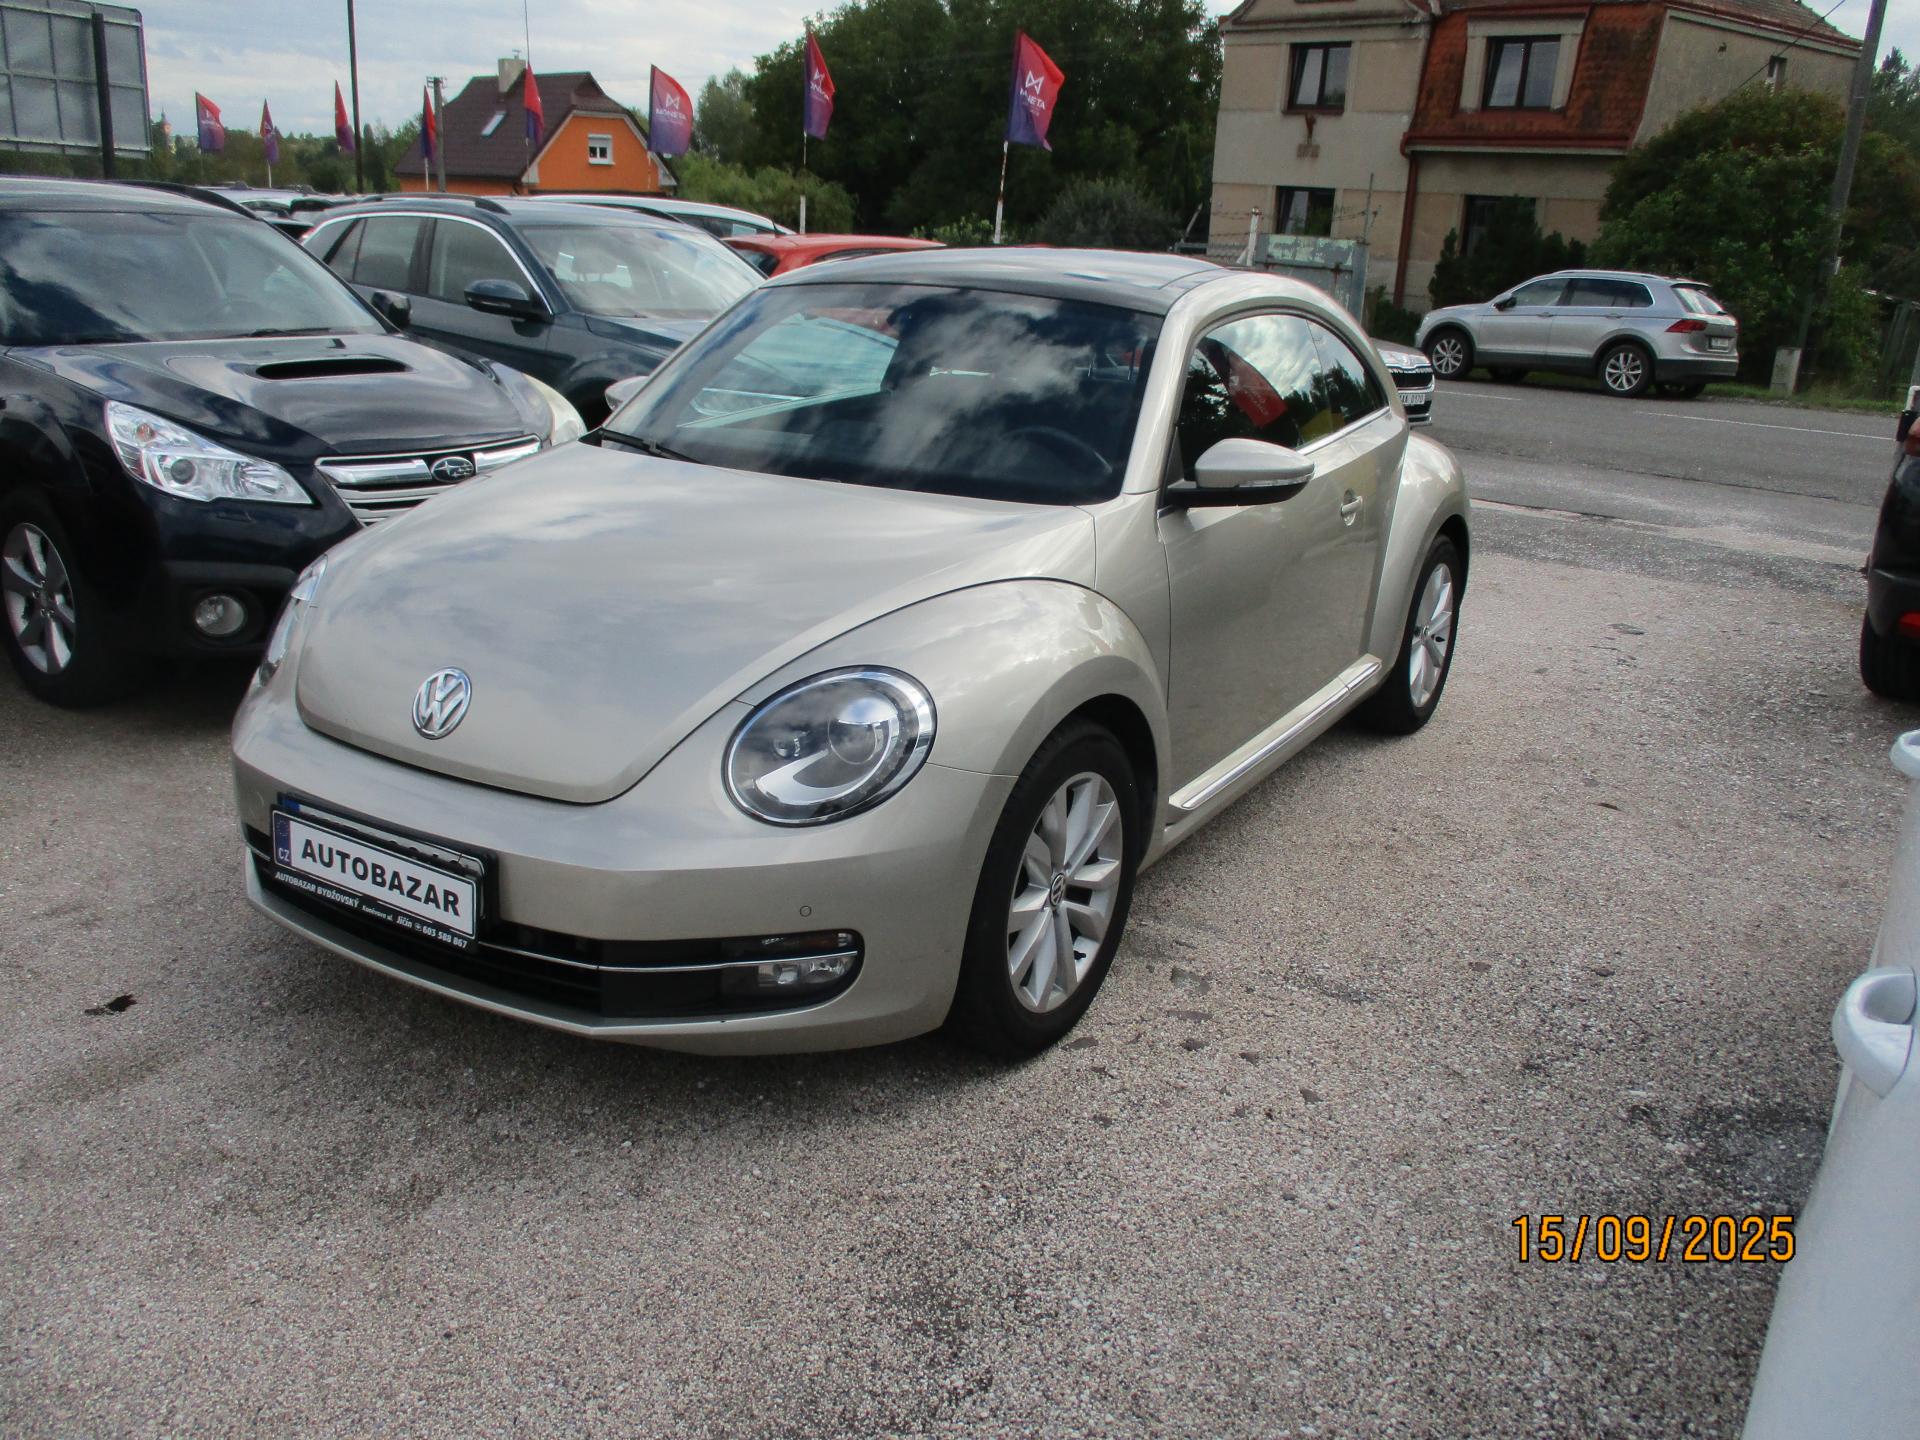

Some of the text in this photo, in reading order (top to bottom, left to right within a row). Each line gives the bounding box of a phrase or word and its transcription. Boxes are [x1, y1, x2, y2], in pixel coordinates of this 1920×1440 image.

[1019, 87, 1045, 110] MNETA
[278, 847, 290, 862] CZ
[301, 838, 461, 917] AUTOBAZAR
[275, 871, 316, 892] AUTOBAZAR
[316, 886, 360, 908] BYDŽOVSKÝ
[422, 925, 436, 937] 603
